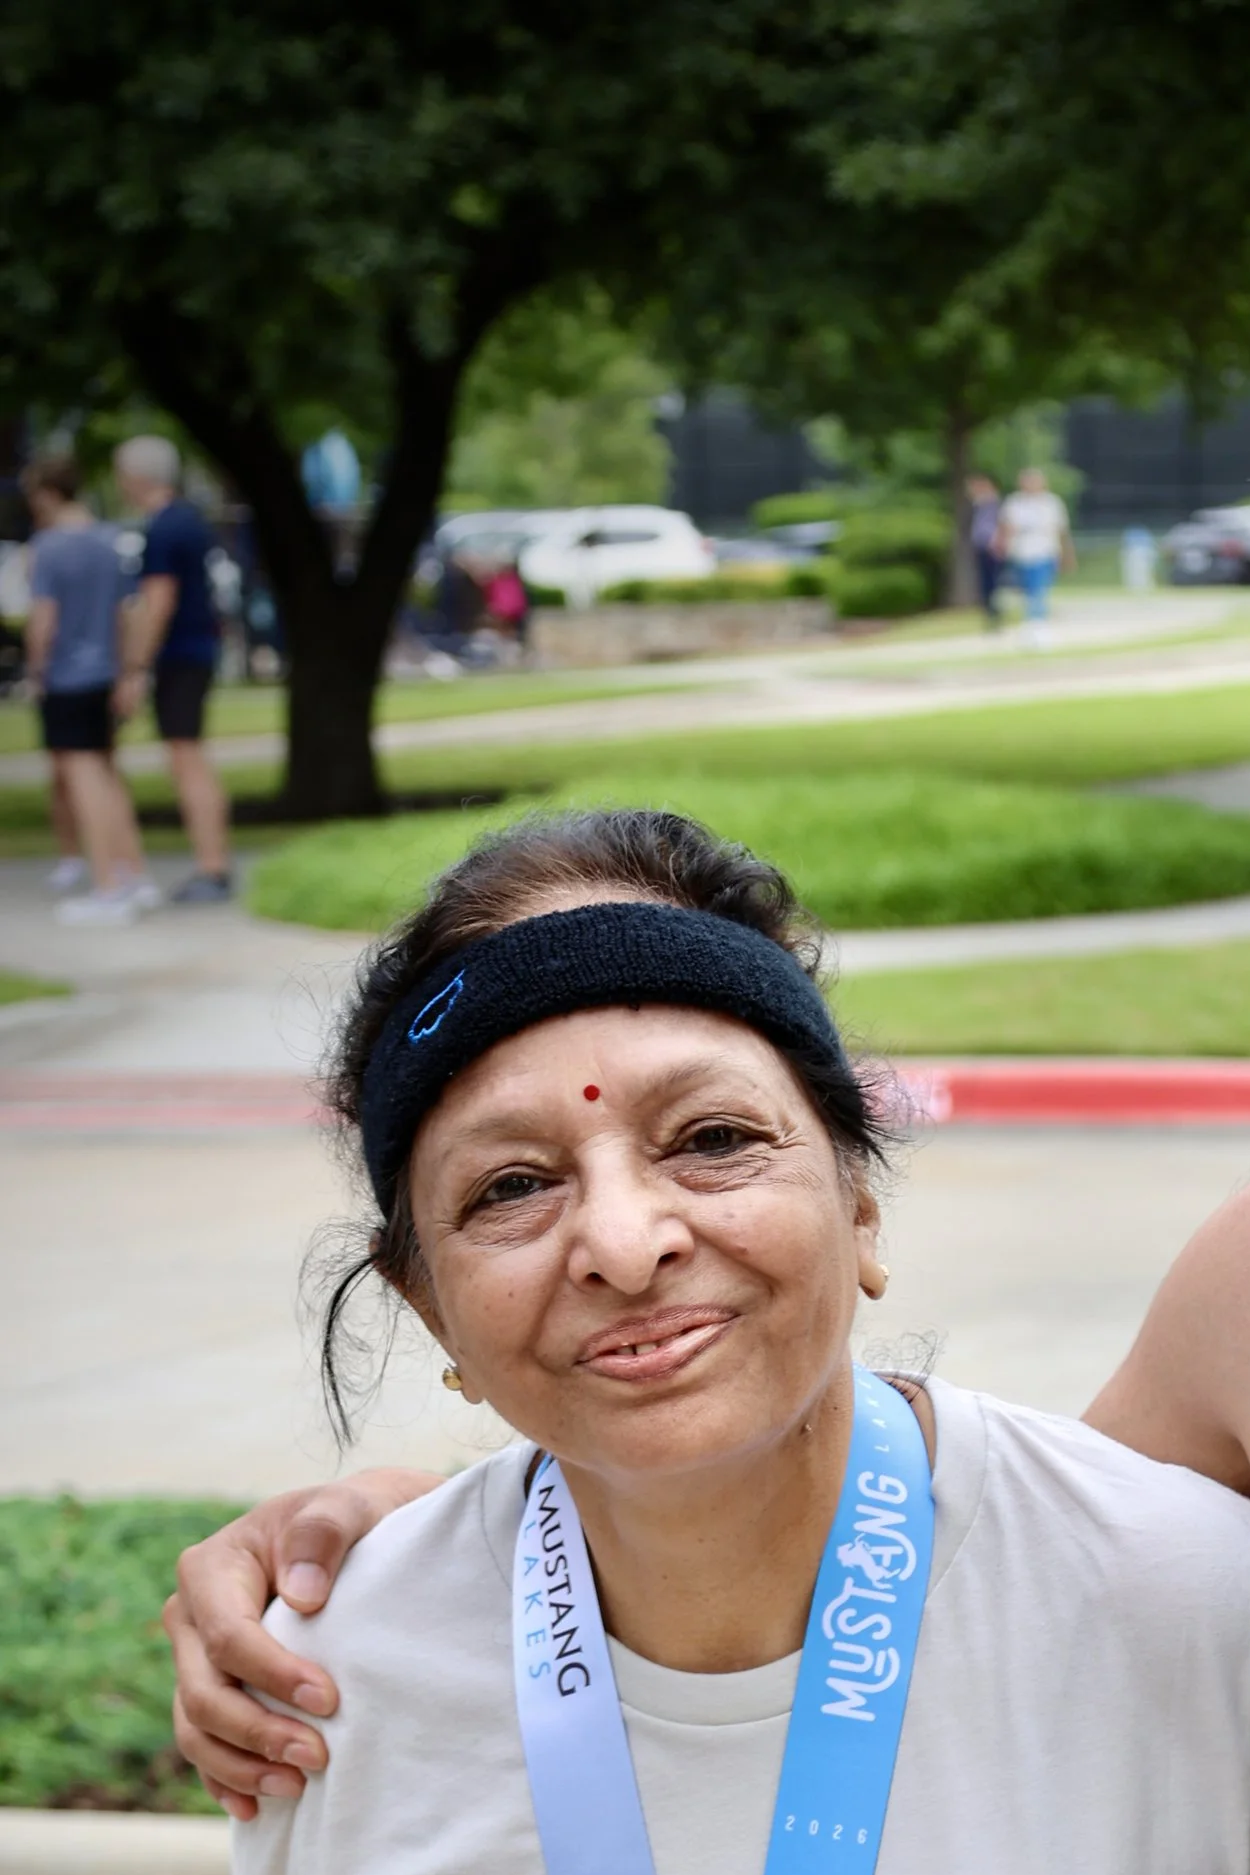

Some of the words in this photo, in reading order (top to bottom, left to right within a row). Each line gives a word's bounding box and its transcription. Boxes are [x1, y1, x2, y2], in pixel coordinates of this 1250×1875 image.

[522, 1520, 552, 1681] LAKES
[537, 1484, 591, 1697] MUSTANG
[820, 1470, 917, 1722] MUSTANG
[784, 1814, 868, 1845] 2026
